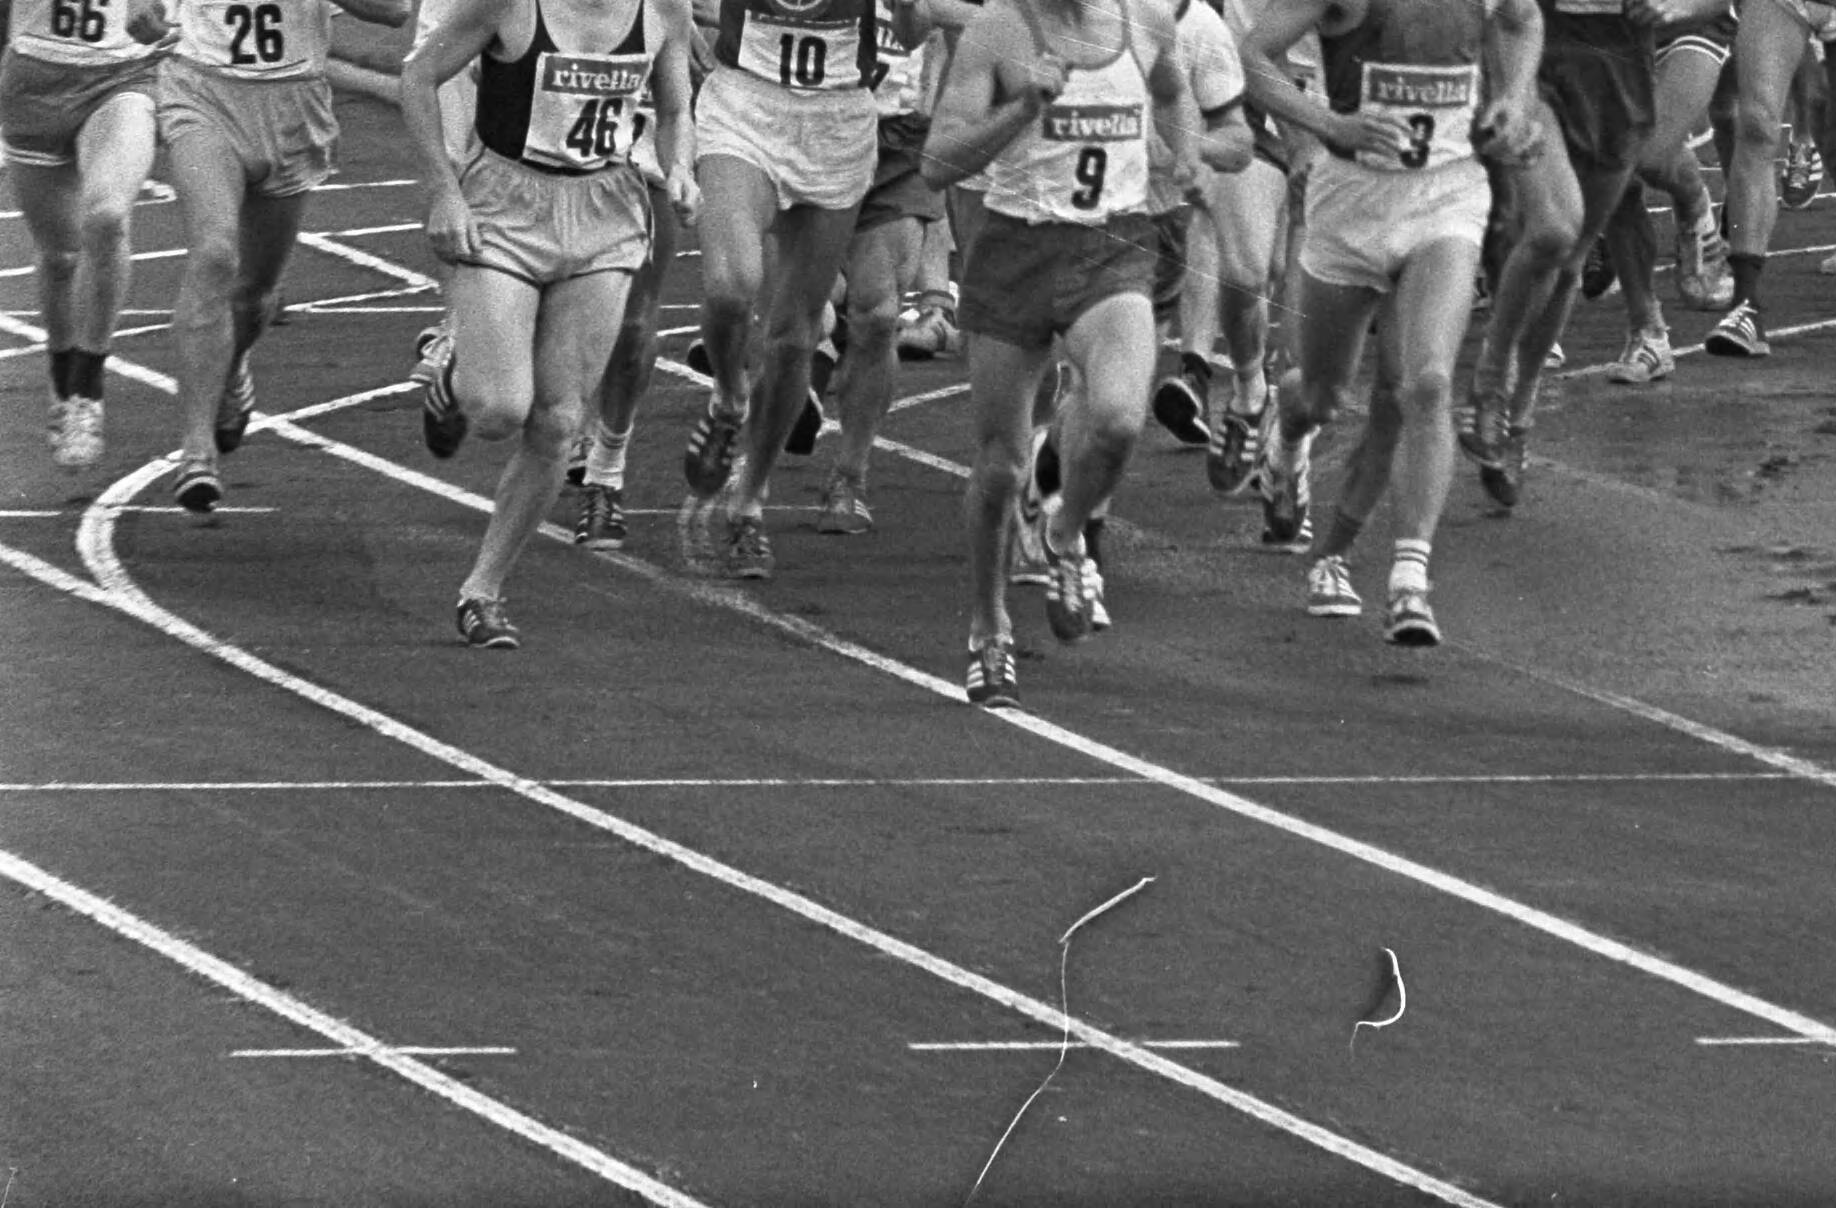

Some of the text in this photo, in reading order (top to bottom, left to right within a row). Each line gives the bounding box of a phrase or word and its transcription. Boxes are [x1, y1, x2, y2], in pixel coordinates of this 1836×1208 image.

[225, 3, 284, 65] 26
[780, 32, 828, 86] 10
[552, 63, 641, 90] rivella
[1376, 76, 1467, 103] rivella
[566, 97, 623, 158] 46
[1052, 110, 1138, 136] rivella
[1401, 113, 1435, 170] 3
[1071, 146, 1107, 211] 9
